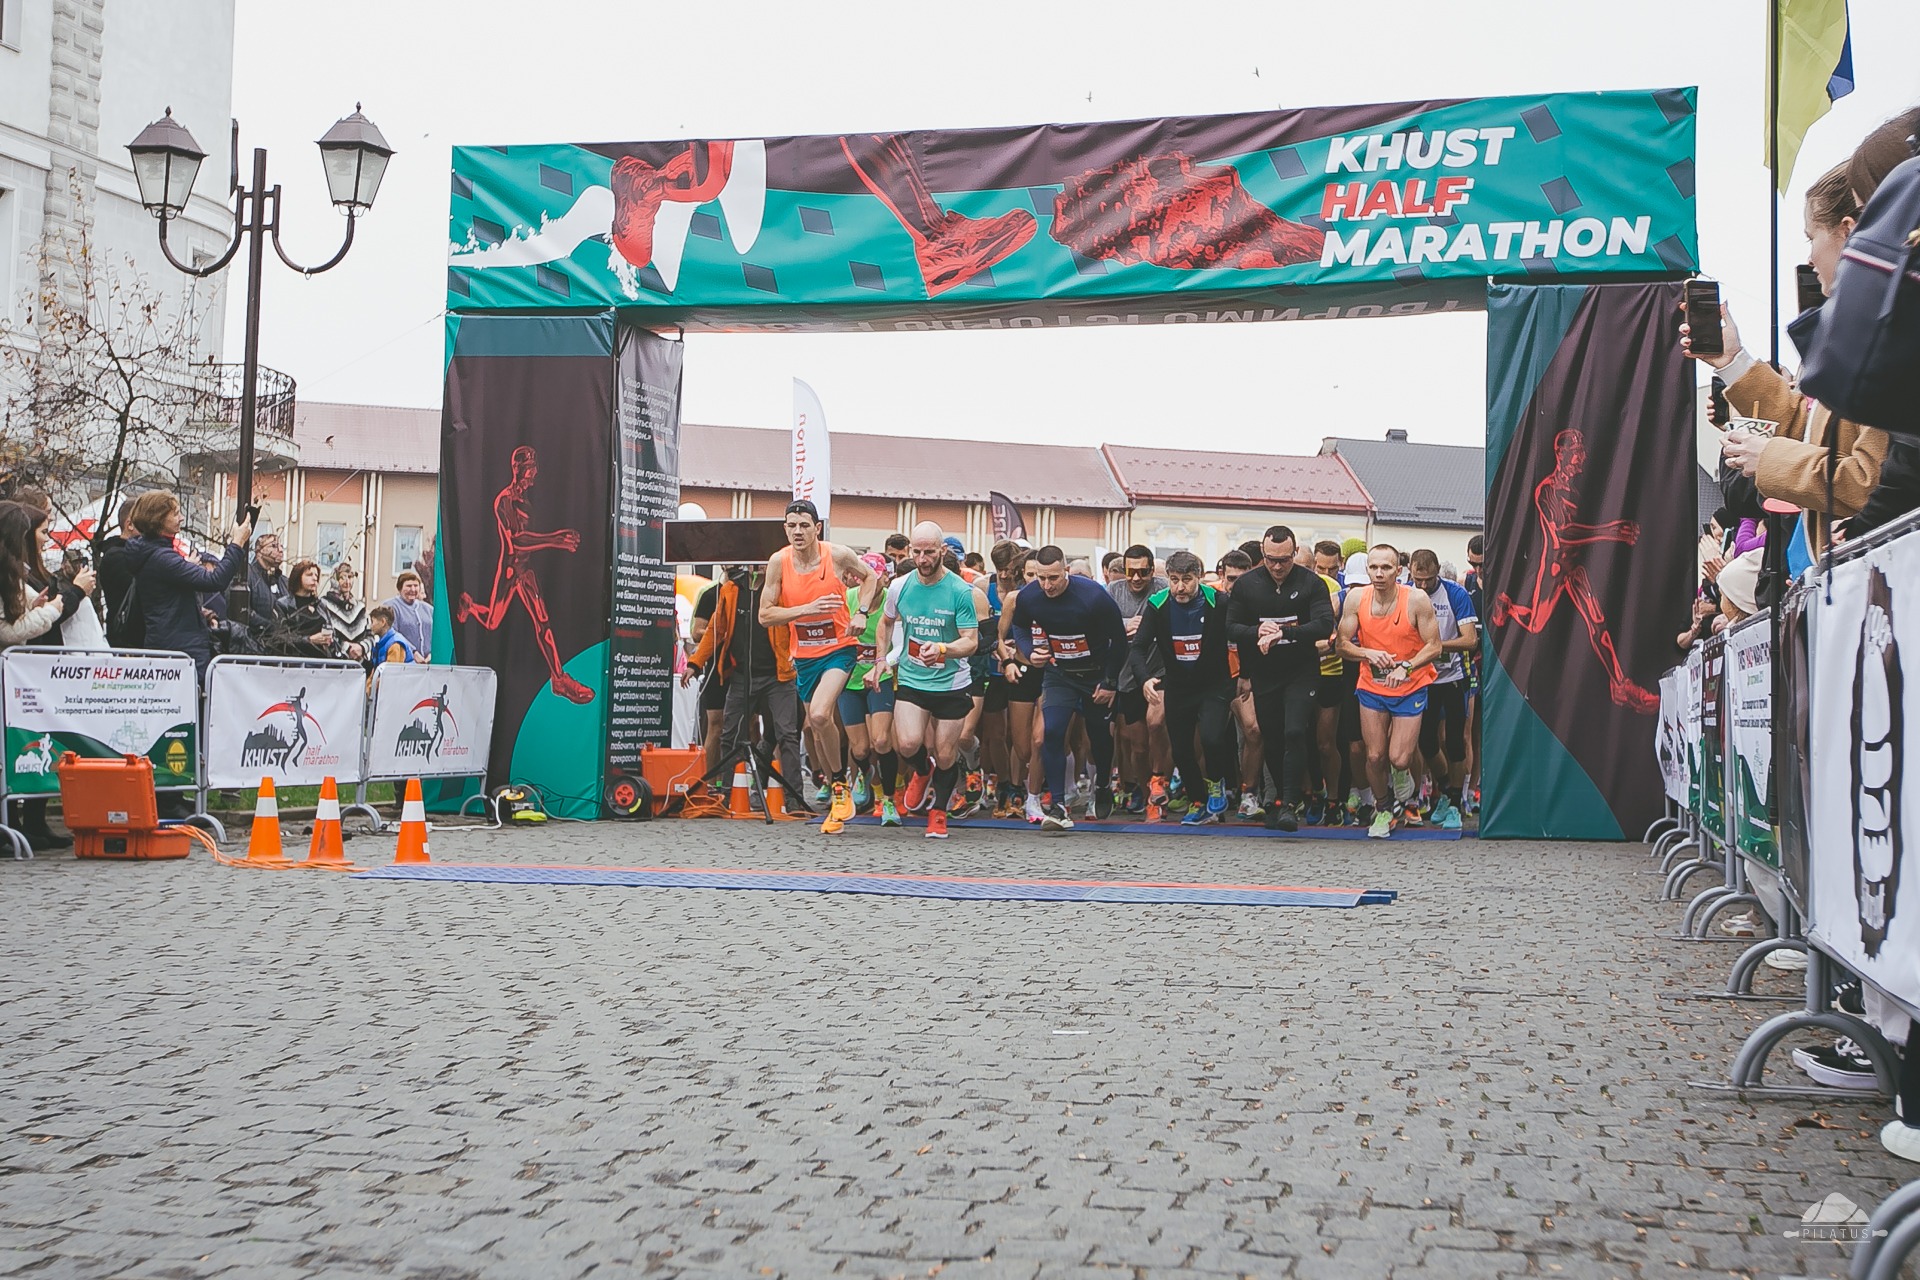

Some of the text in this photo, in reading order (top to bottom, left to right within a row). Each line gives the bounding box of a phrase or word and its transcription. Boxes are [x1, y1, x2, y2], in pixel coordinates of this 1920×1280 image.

[1325, 126, 1515, 174] KHUST
[1320, 176, 1475, 222] HALF
[1319, 215, 1651, 268] MARATHON
[806, 628, 824, 637] 169
[913, 627, 940, 636] TEAM
[1184, 643, 1200, 651] 181
[50, 666, 181, 681] KHUST HALF MARATHON
[306, 744, 322, 757] half
[395, 740, 432, 757] KHUST
[243, 748, 339, 767] KHUST marathon
